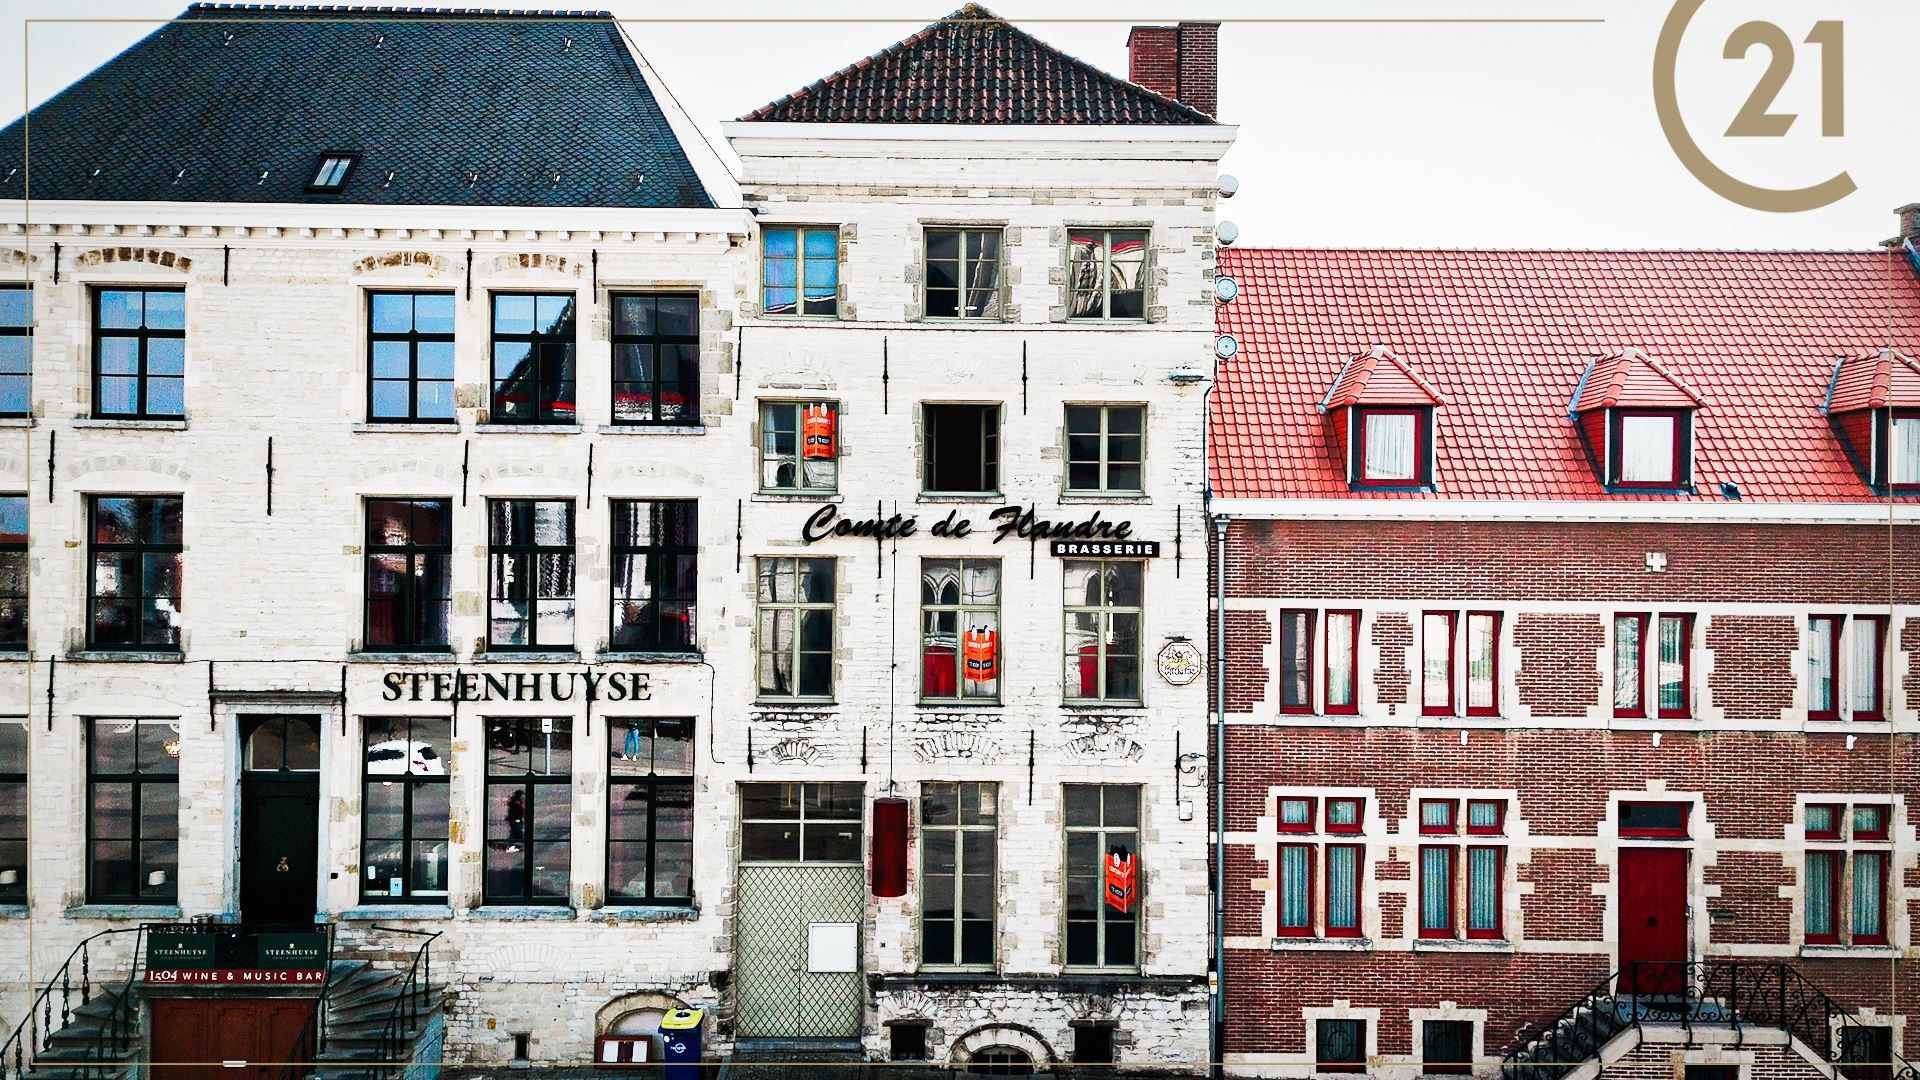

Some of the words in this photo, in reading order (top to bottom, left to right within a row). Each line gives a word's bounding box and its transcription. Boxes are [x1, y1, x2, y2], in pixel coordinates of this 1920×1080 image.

[931, 509, 973, 538] de
[988, 505, 1134, 544] Flandre
[1056, 543, 1154, 555] BRASSERIE
[382, 672, 652, 701] STEENHUYSE
[150, 970, 178, 981] 1504
[182, 972, 218, 981] WINE
[226, 972, 234, 981] &
[243, 972, 288, 981] MUSIC
[296, 972, 322, 981] BAR
